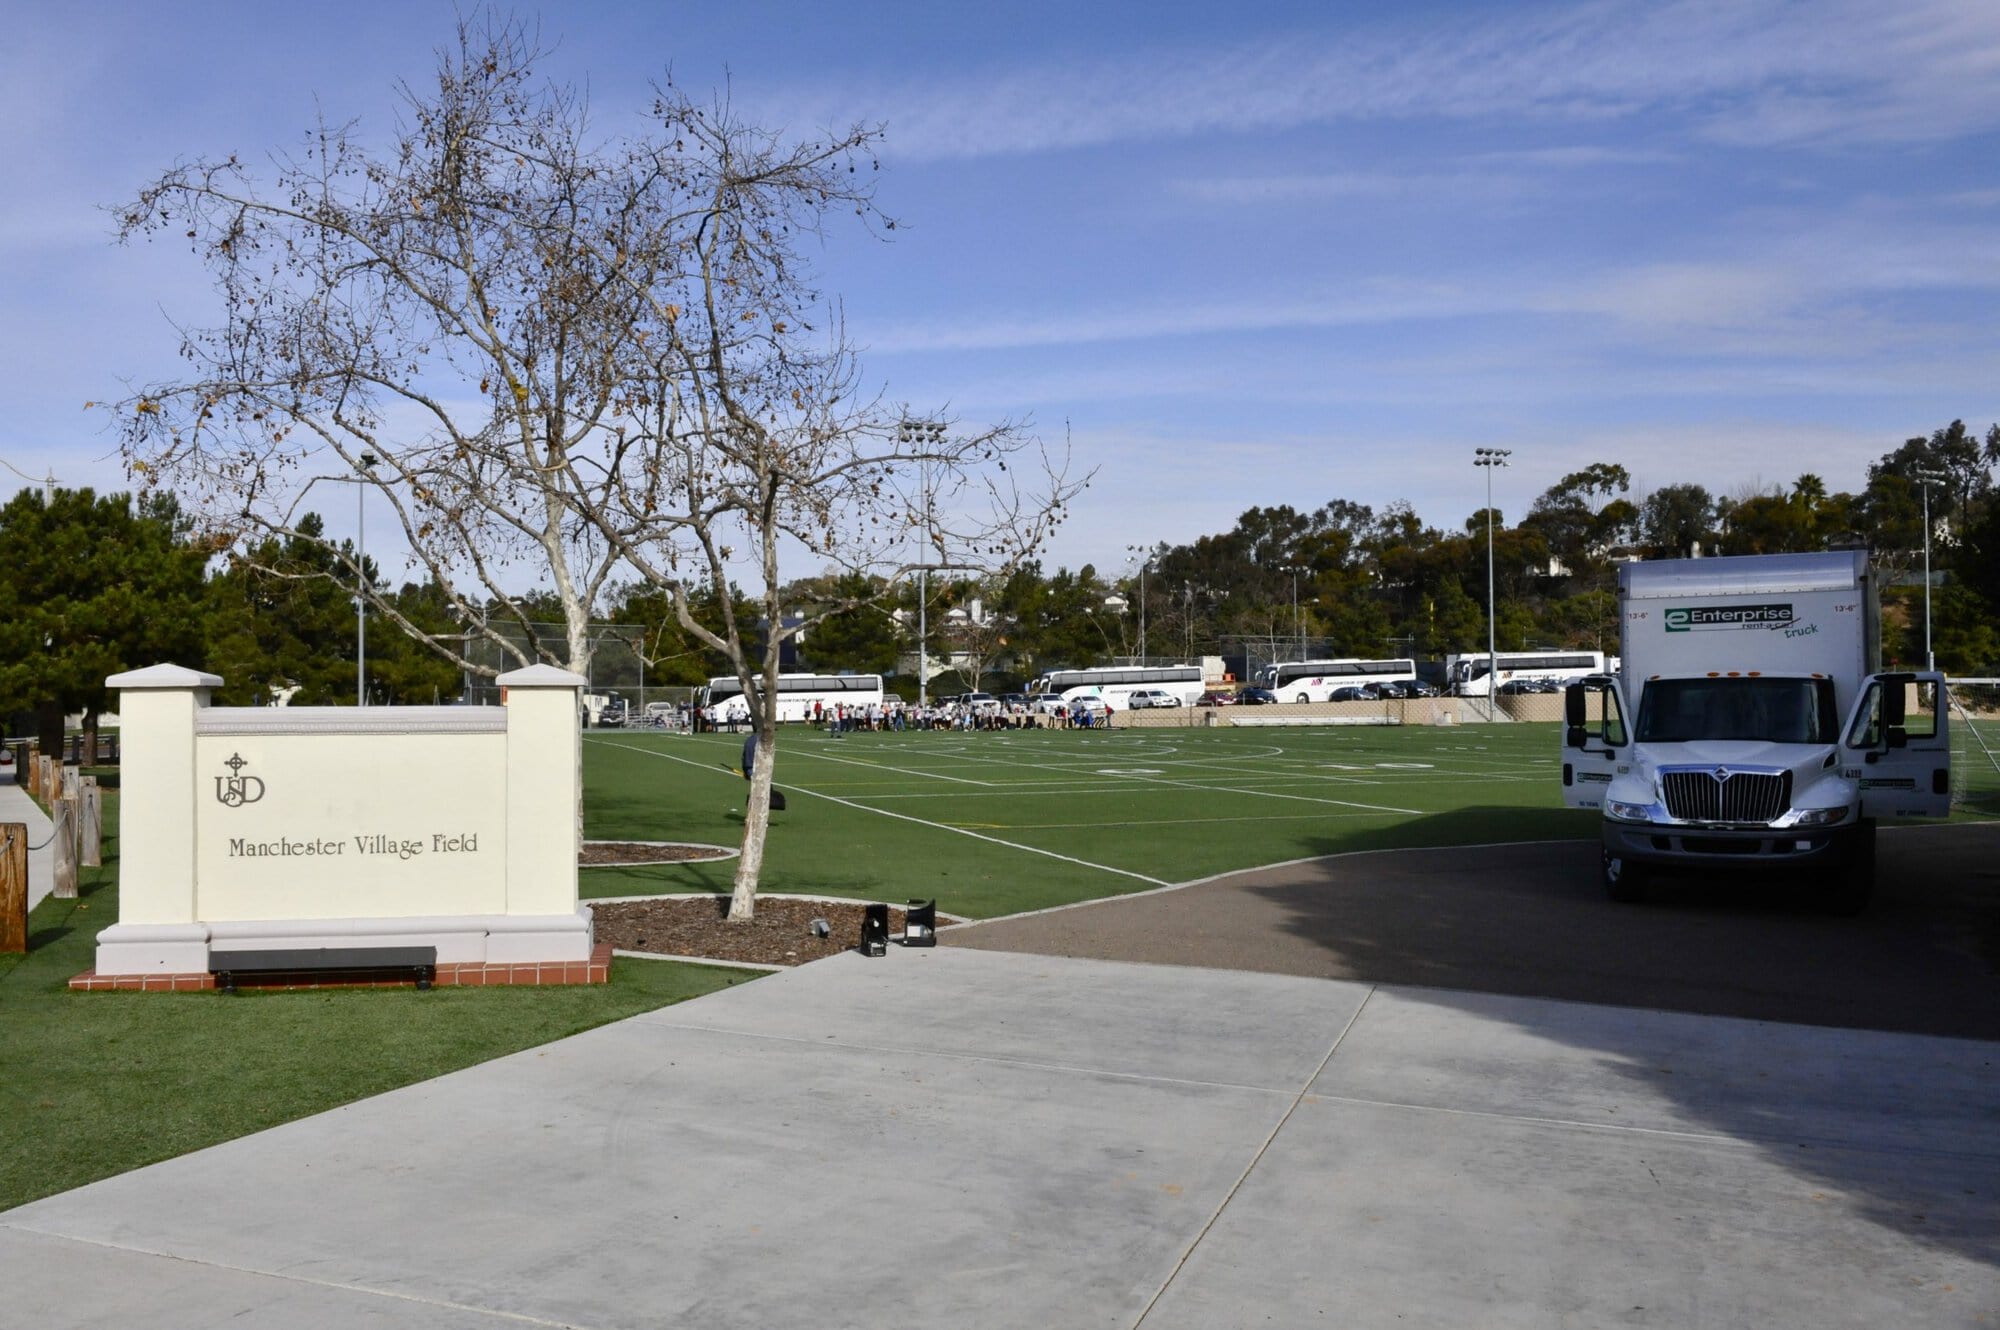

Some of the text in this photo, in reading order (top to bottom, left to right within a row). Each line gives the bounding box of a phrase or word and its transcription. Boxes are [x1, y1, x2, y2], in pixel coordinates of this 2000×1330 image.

[1691, 606, 1792, 623] Enterprise
[1784, 624, 1819, 639] truck
[229, 832, 479, 860] Manchester Village Field
